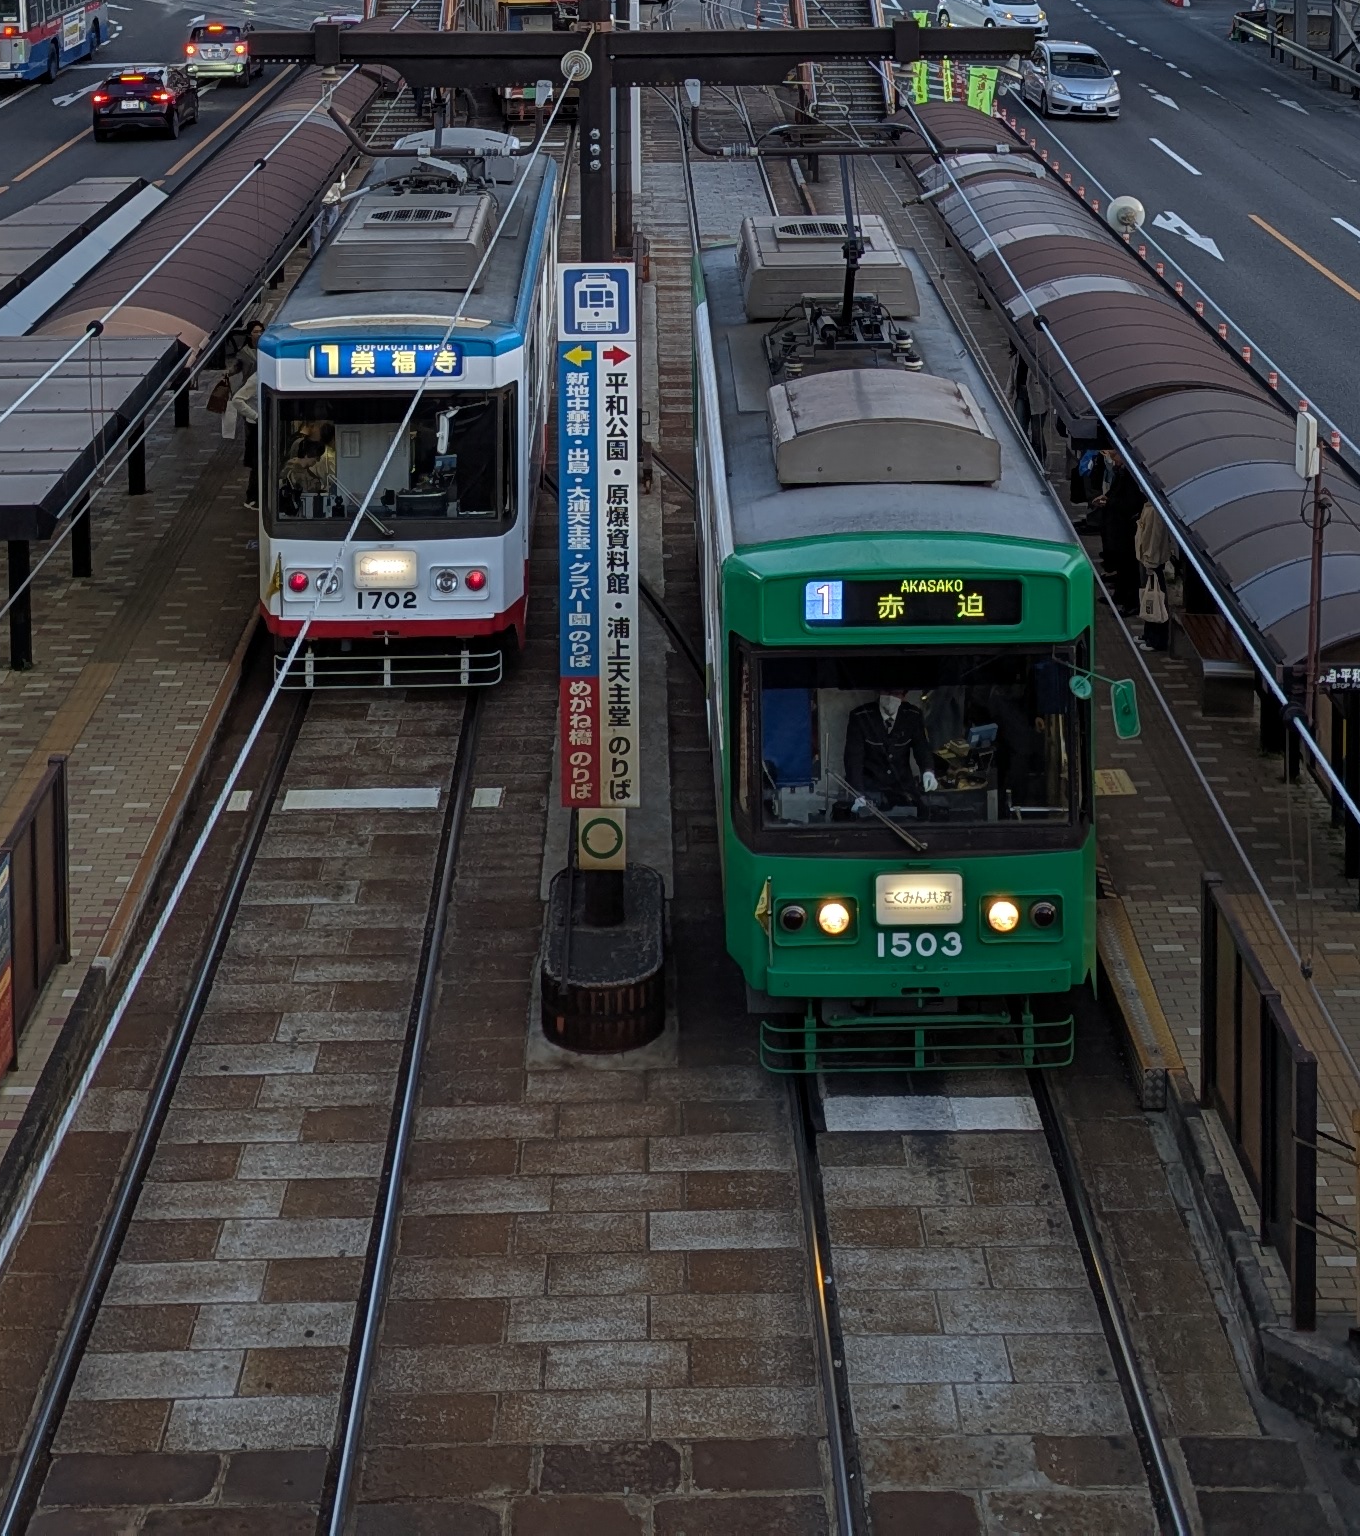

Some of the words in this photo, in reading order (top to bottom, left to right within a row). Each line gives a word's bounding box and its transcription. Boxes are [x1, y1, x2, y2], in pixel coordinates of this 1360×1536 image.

[321, 345, 339, 375] 1
[351, 351, 457, 375] 崇福寺
[605, 372, 631, 727] 平和公園・原爆資料館・浦上天主堂
[357, 591, 417, 610] 1702
[817, 584, 830, 615] 1
[877, 593, 985, 619] 赤迫
[900, 579, 964, 593] AKASAKO
[568, 630, 591, 668] のりば
[568, 681, 592, 746] めがね橋
[569, 751, 592, 800] のりば
[608, 736, 631, 801] のりば
[884, 891, 953, 904] こくみん共済
[877, 931, 963, 958] 1503
